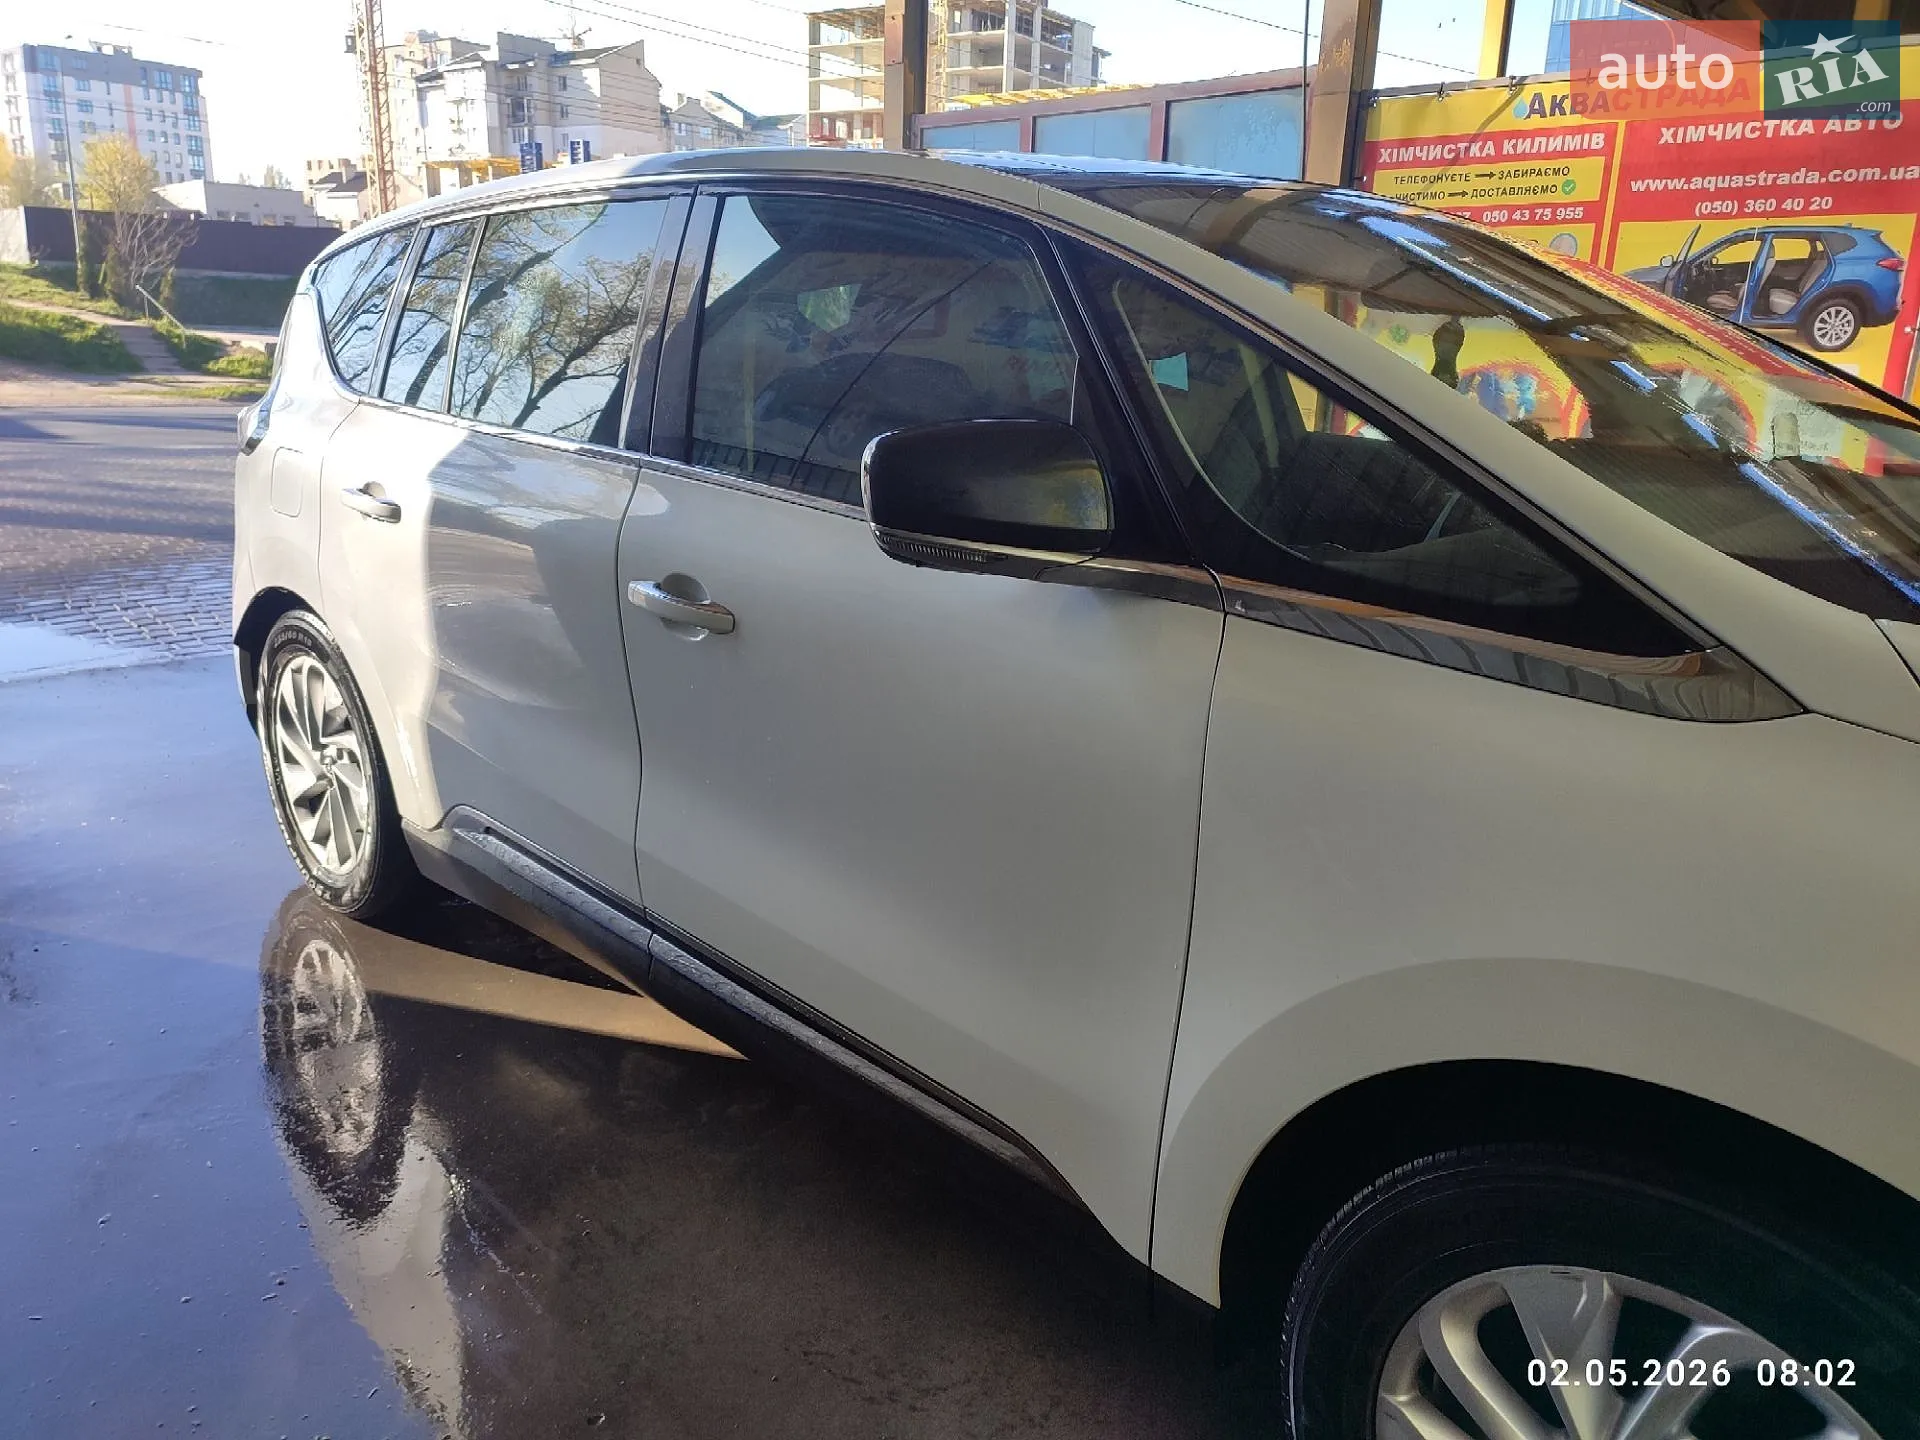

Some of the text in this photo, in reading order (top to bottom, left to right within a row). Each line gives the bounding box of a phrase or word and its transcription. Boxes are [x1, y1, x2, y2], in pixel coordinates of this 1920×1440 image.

[1658, 111, 1904, 144] ХІМЧИСТКА АВТО
[1378, 133, 1605, 163] ХІМЧИСТКА КИЛИМІВ
[1394, 166, 1570, 185] ТЕЛЕФОНУЄТЕ ЗАБИРАЄМО
[1630, 165, 1920, 192] www.aquastrada.com.ua
[1470, 184, 1558, 199] ДОСТАВЛЯЄМО
[1482, 210, 1508, 222] 050
[1512, 209, 1530, 221] 43
[1534, 208, 1552, 220] 75
[1555, 207, 1584, 220] 955
[1695, 196, 1833, 216] (050) 360 40 20
